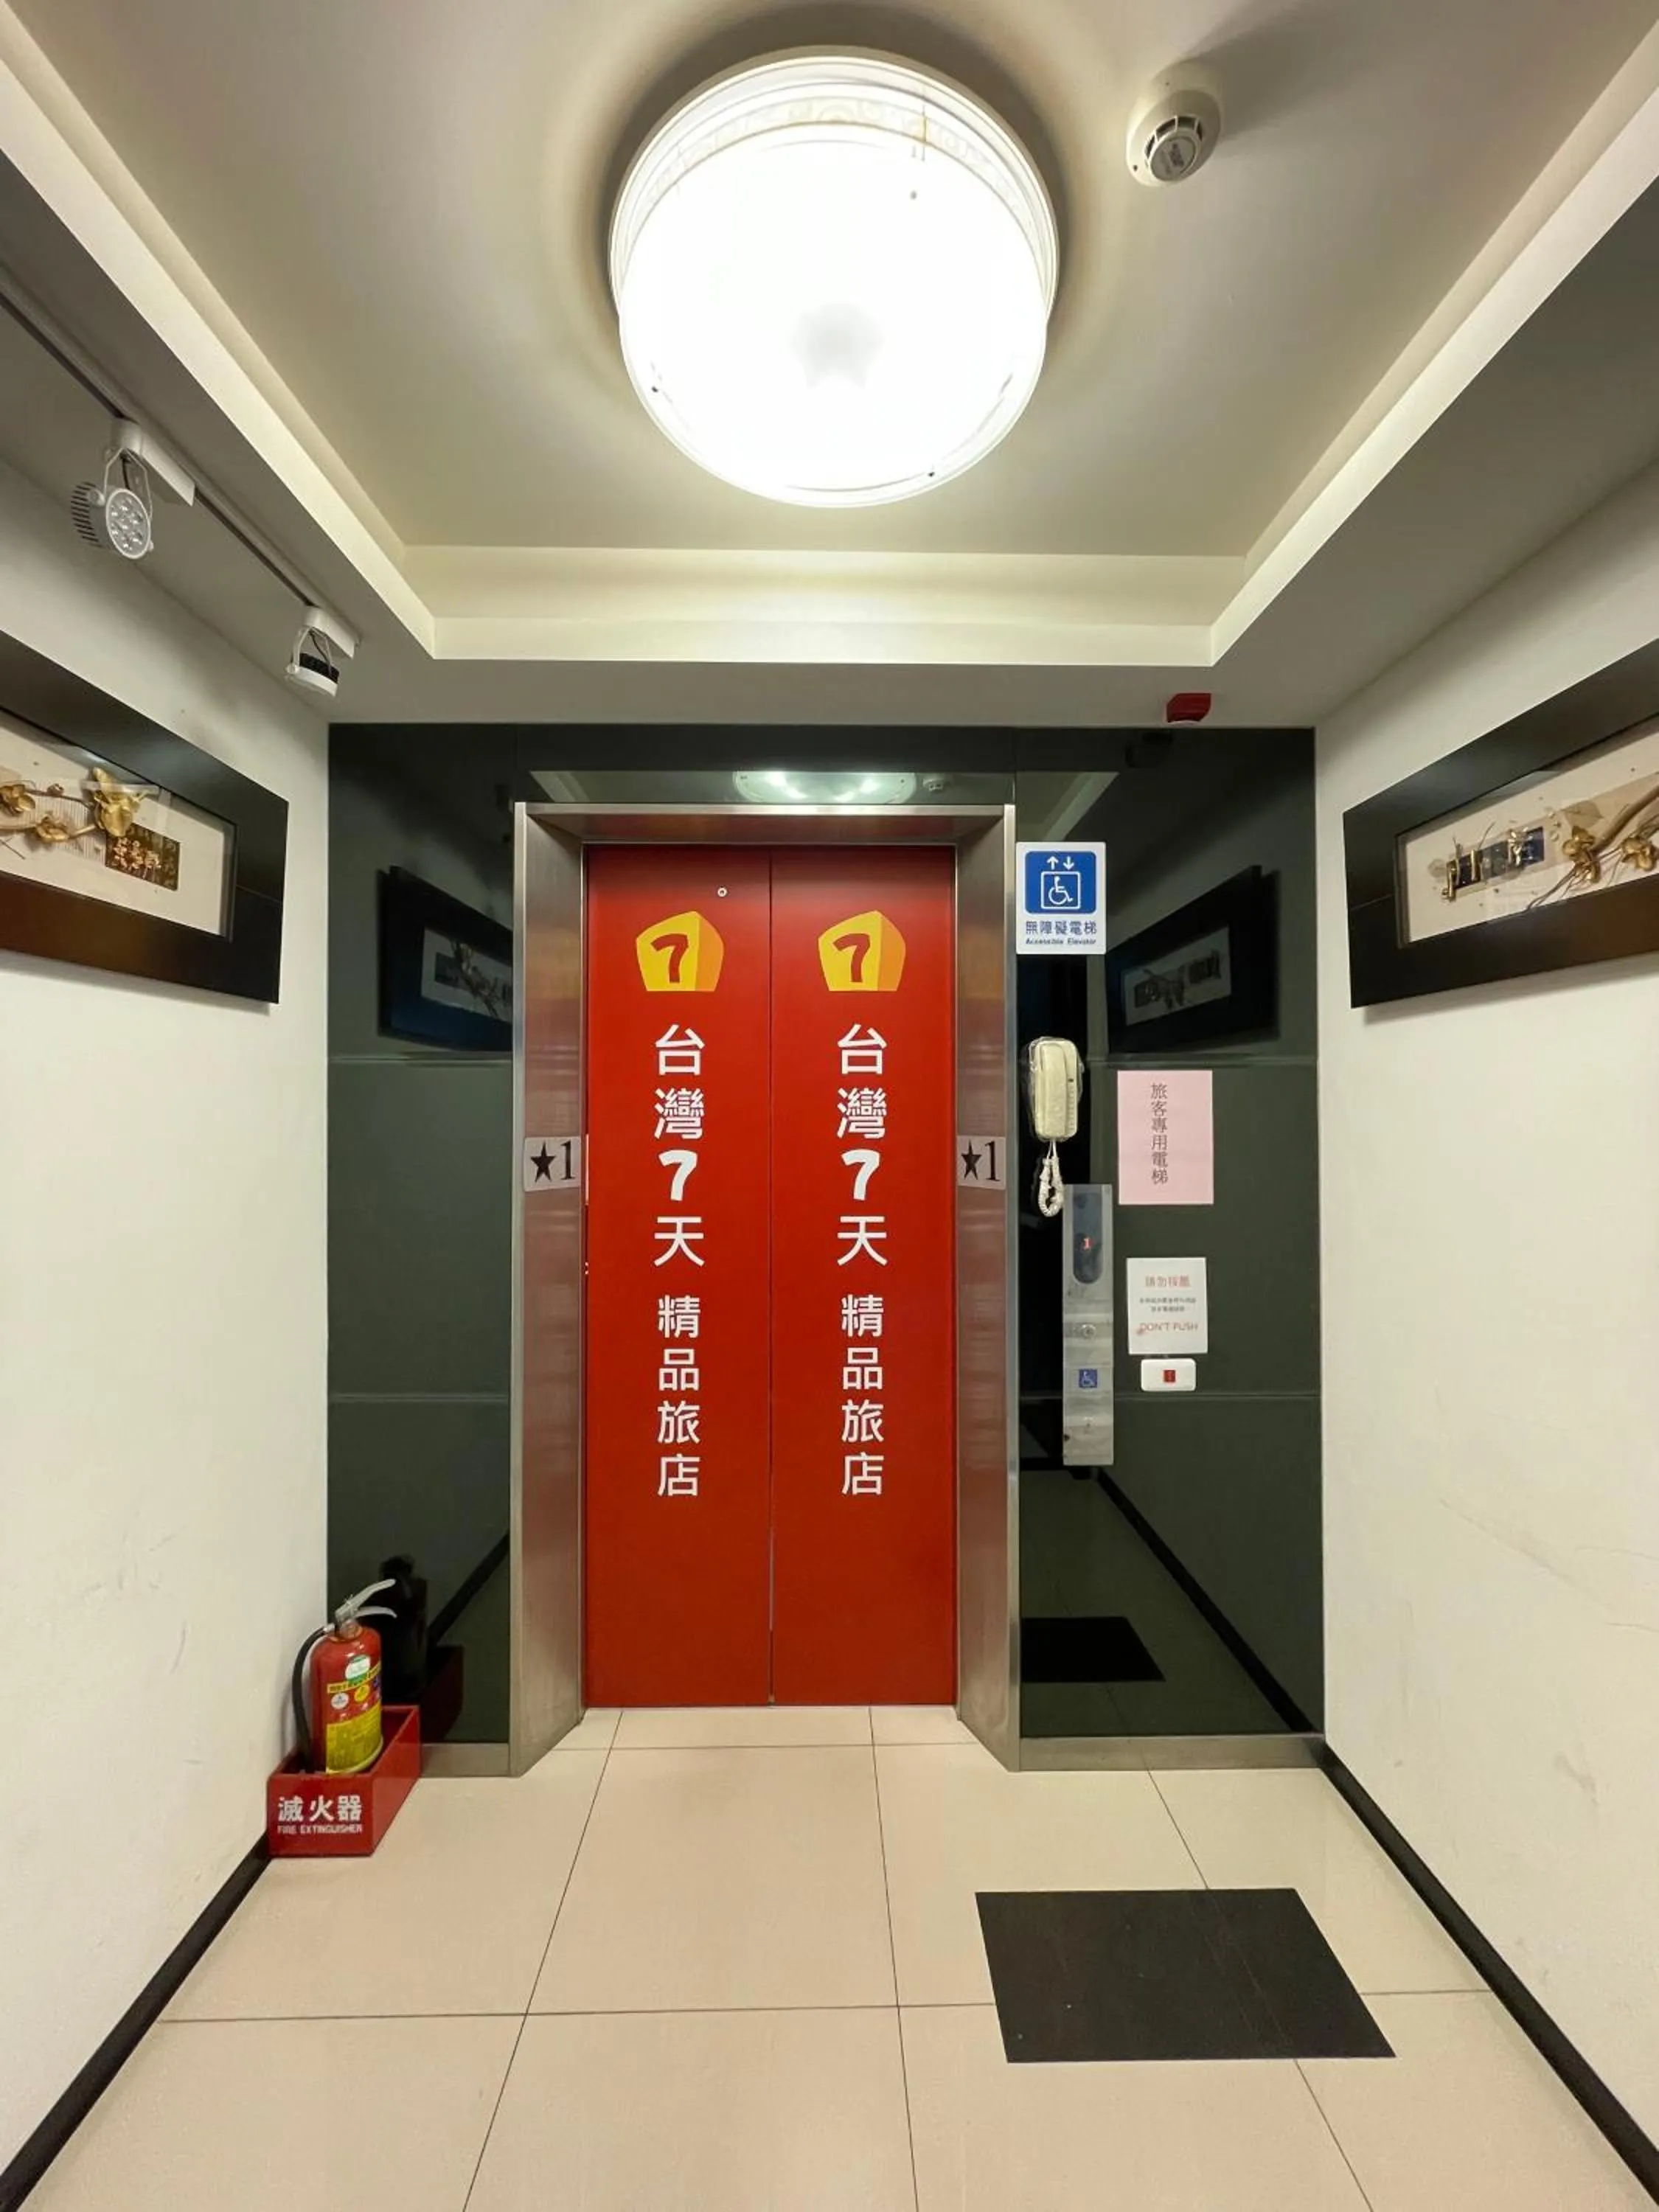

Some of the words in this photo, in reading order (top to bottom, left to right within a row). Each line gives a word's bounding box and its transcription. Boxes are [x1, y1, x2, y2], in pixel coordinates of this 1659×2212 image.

[1026, 920, 1097, 935] 無障礙電梯
[650, 933, 689, 983] 7
[833, 933, 871, 983] 7
[653, 1024, 705, 1267] 台灣7天
[837, 1023, 888, 1266] 台灣7天
[1150, 1082, 1169, 1186] 旅客專用電梯
[1174, 1322, 1198, 1332] PUSH
[657, 1295, 701, 1496] 精品旅店
[841, 1294, 884, 1495] 精品旅店
[277, 1795, 363, 1822] 滅火器
[277, 1825, 297, 1834] FIRE
[300, 1824, 363, 1834] EXTINGUISHER
